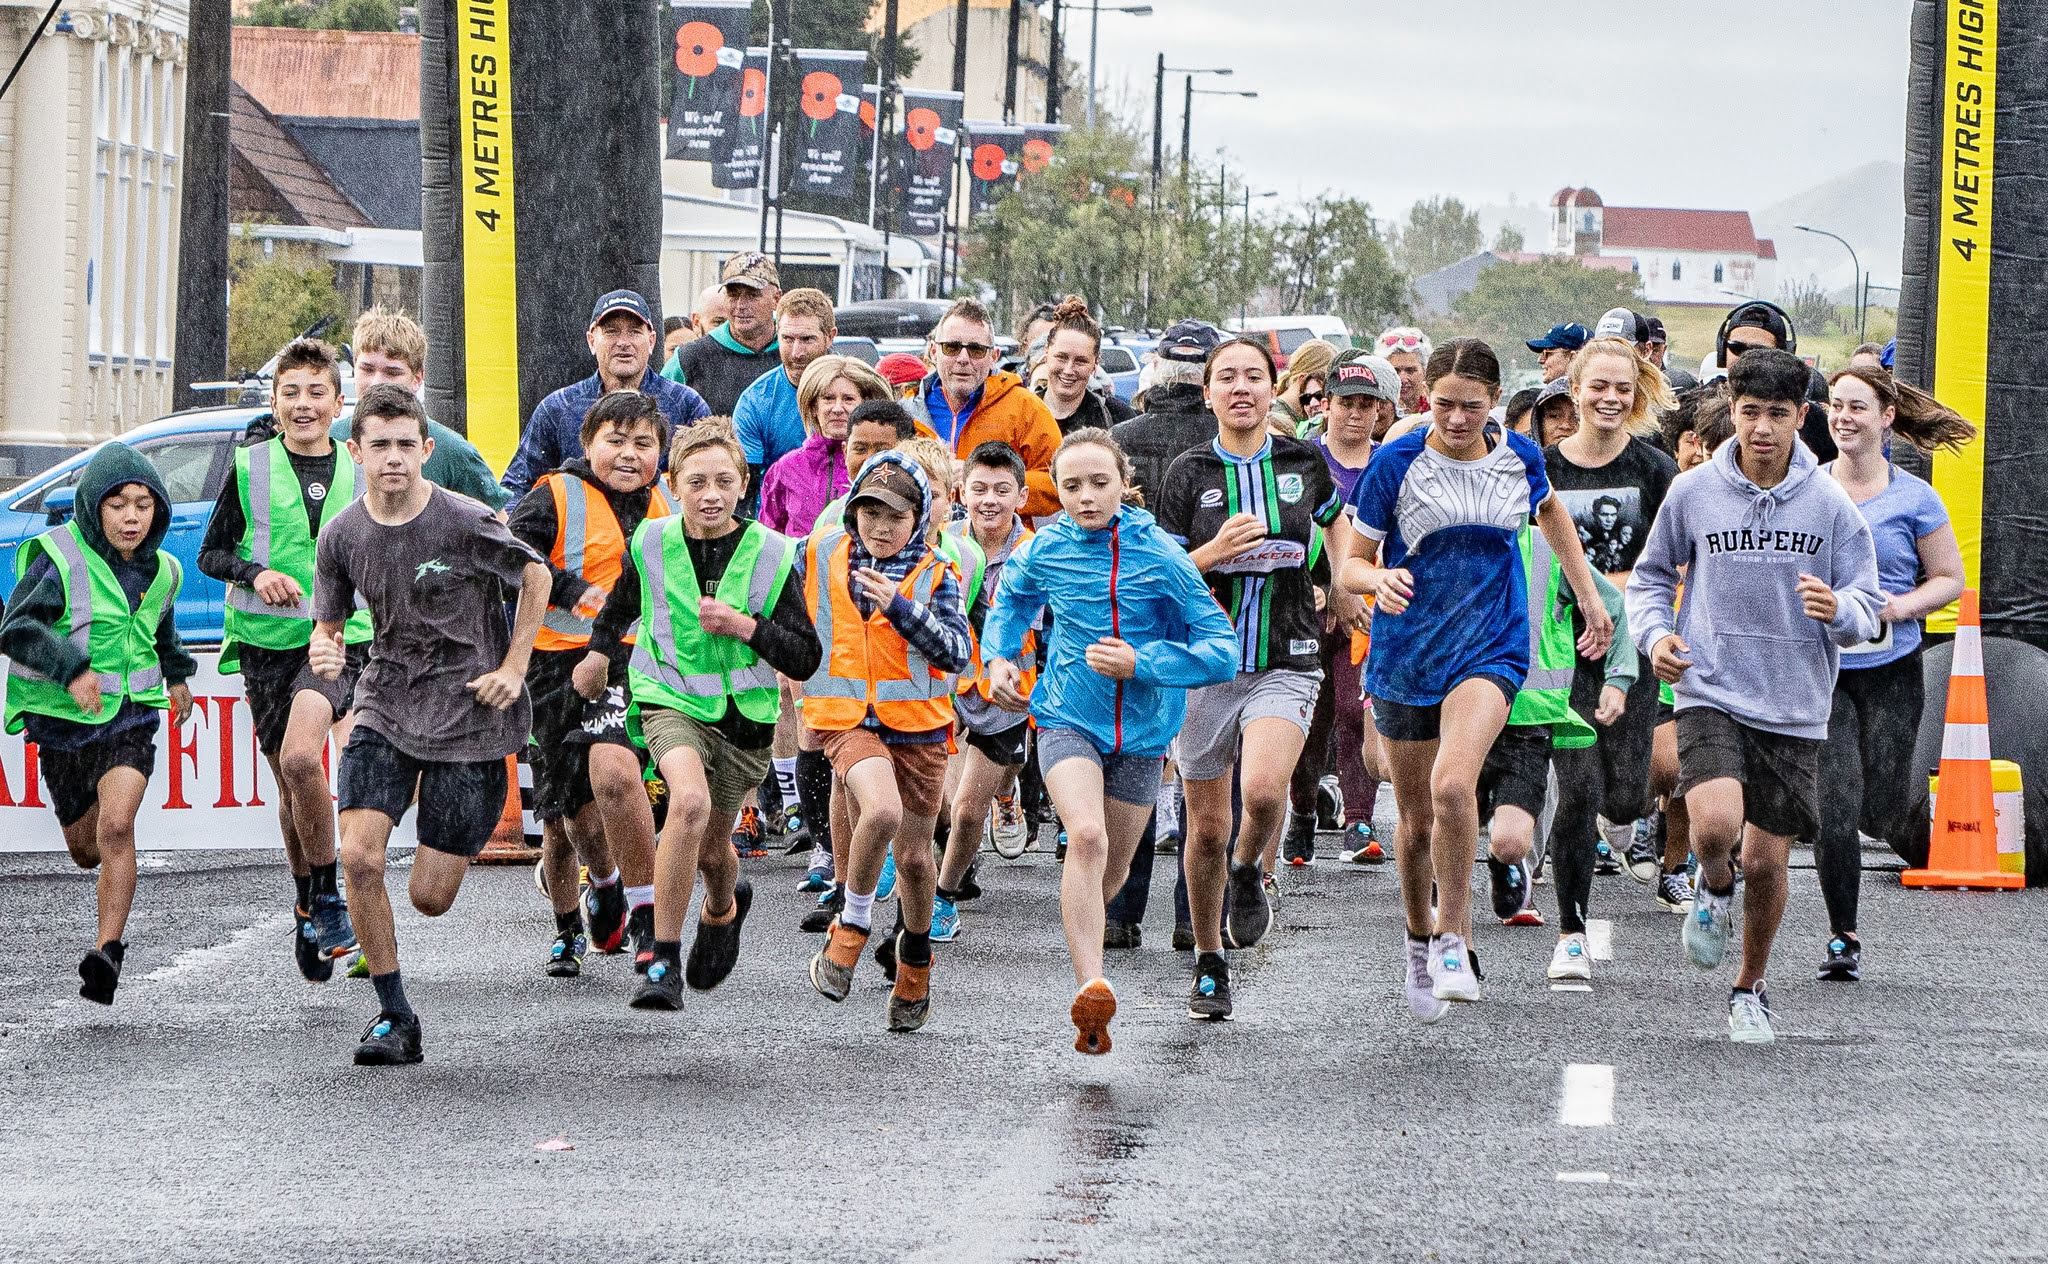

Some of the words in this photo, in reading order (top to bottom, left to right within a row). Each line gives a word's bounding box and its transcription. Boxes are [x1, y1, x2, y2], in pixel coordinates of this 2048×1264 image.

[471, 54, 500, 197] METRES
[684, 110, 700, 124] We
[702, 111, 723, 124] will
[676, 124, 726, 138] remember
[821, 150, 842, 161] will
[1953, 82, 1982, 227] METRES
[801, 162, 844, 174] remember
[475, 208, 501, 232] 4
[1952, 237, 1978, 262] 4
[1705, 528, 1825, 556] RUAPEHU
